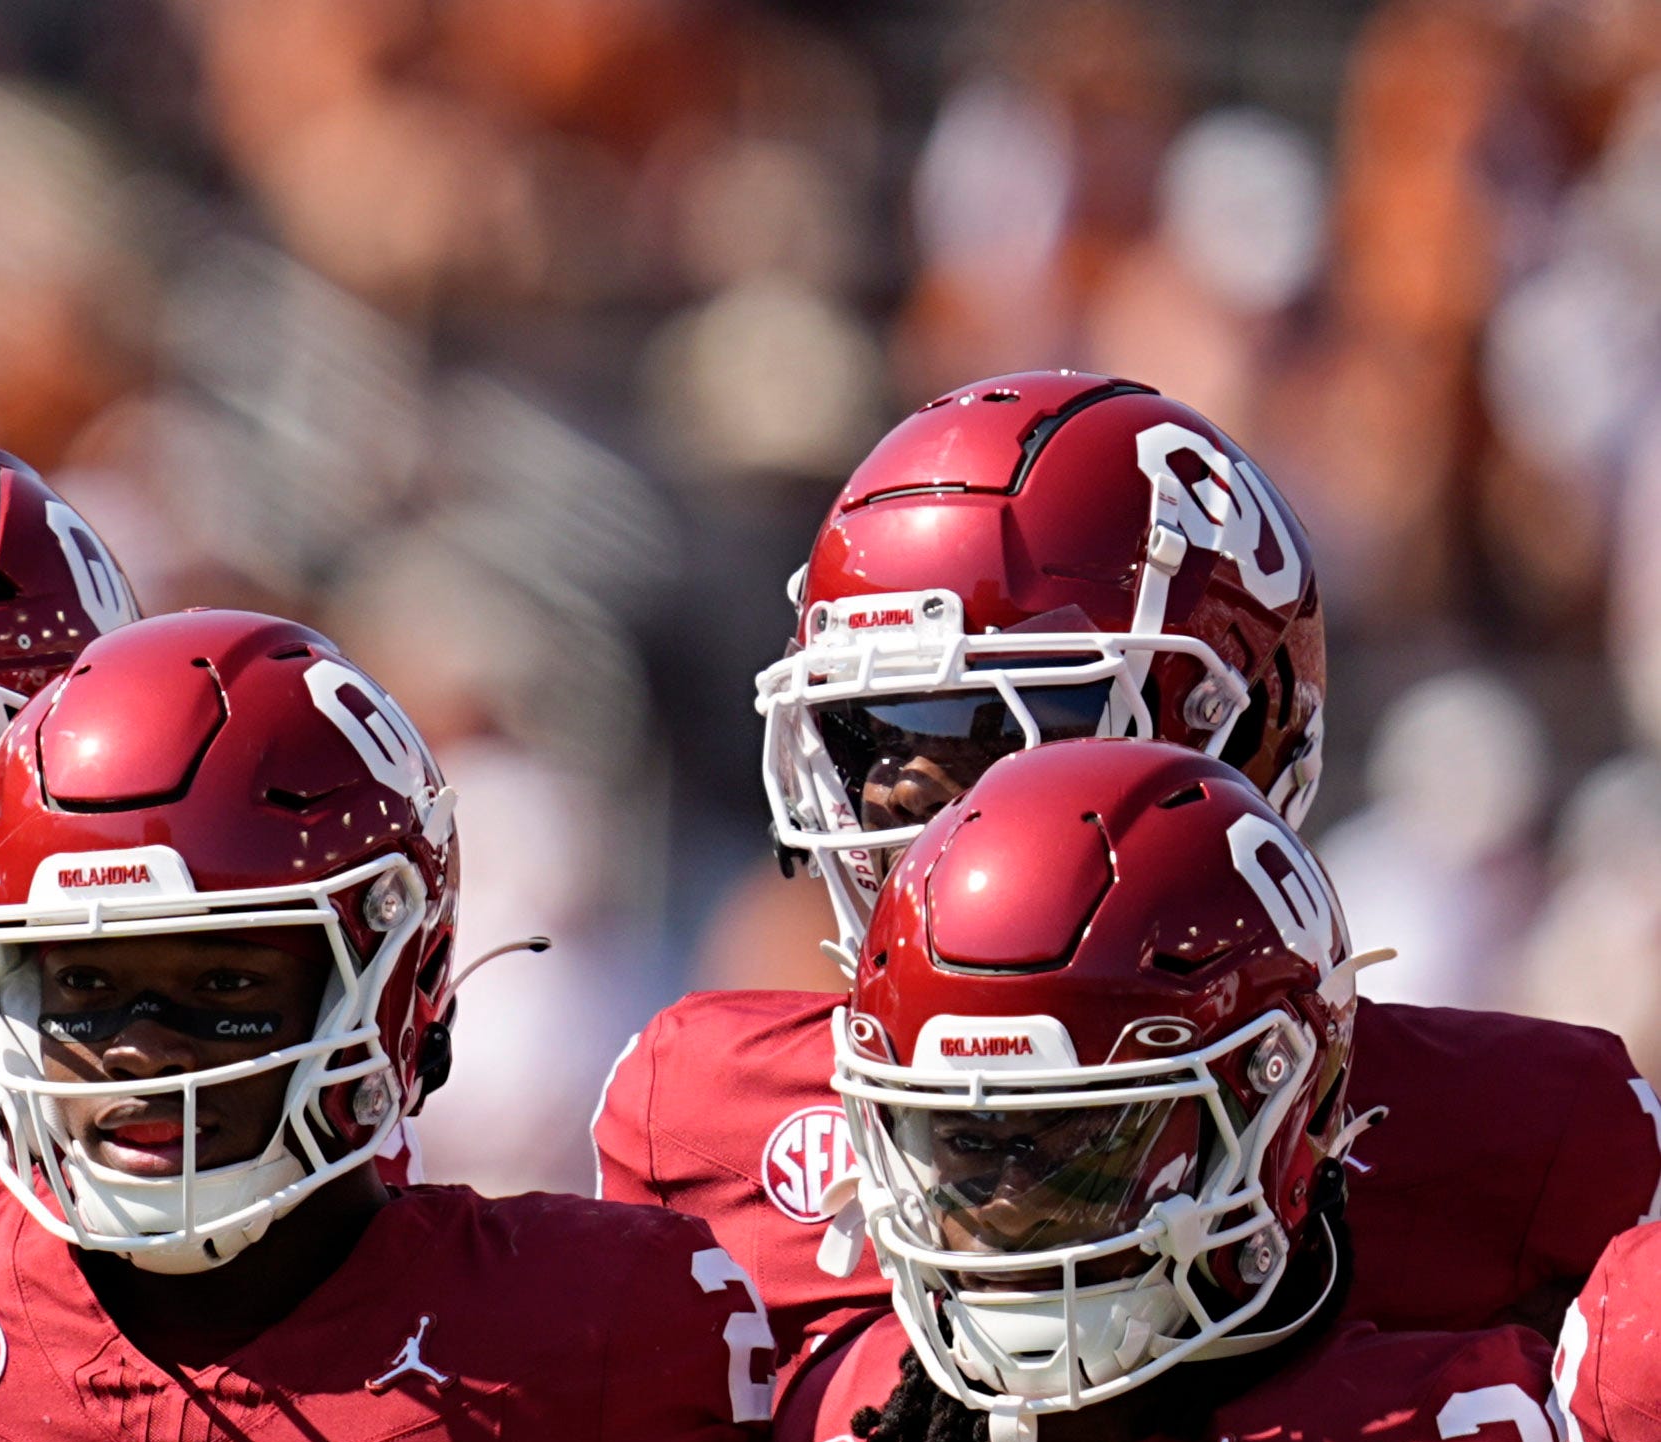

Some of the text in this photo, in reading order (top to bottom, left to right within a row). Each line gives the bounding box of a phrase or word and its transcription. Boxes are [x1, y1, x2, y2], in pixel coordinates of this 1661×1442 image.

[1136, 421, 1302, 610] OU
[44, 500, 141, 636] O
[58, 864, 151, 888] OKLAHOMA
[839, 820, 879, 892] SPOT
[940, 1037, 1033, 1059] OKLAHOMA
